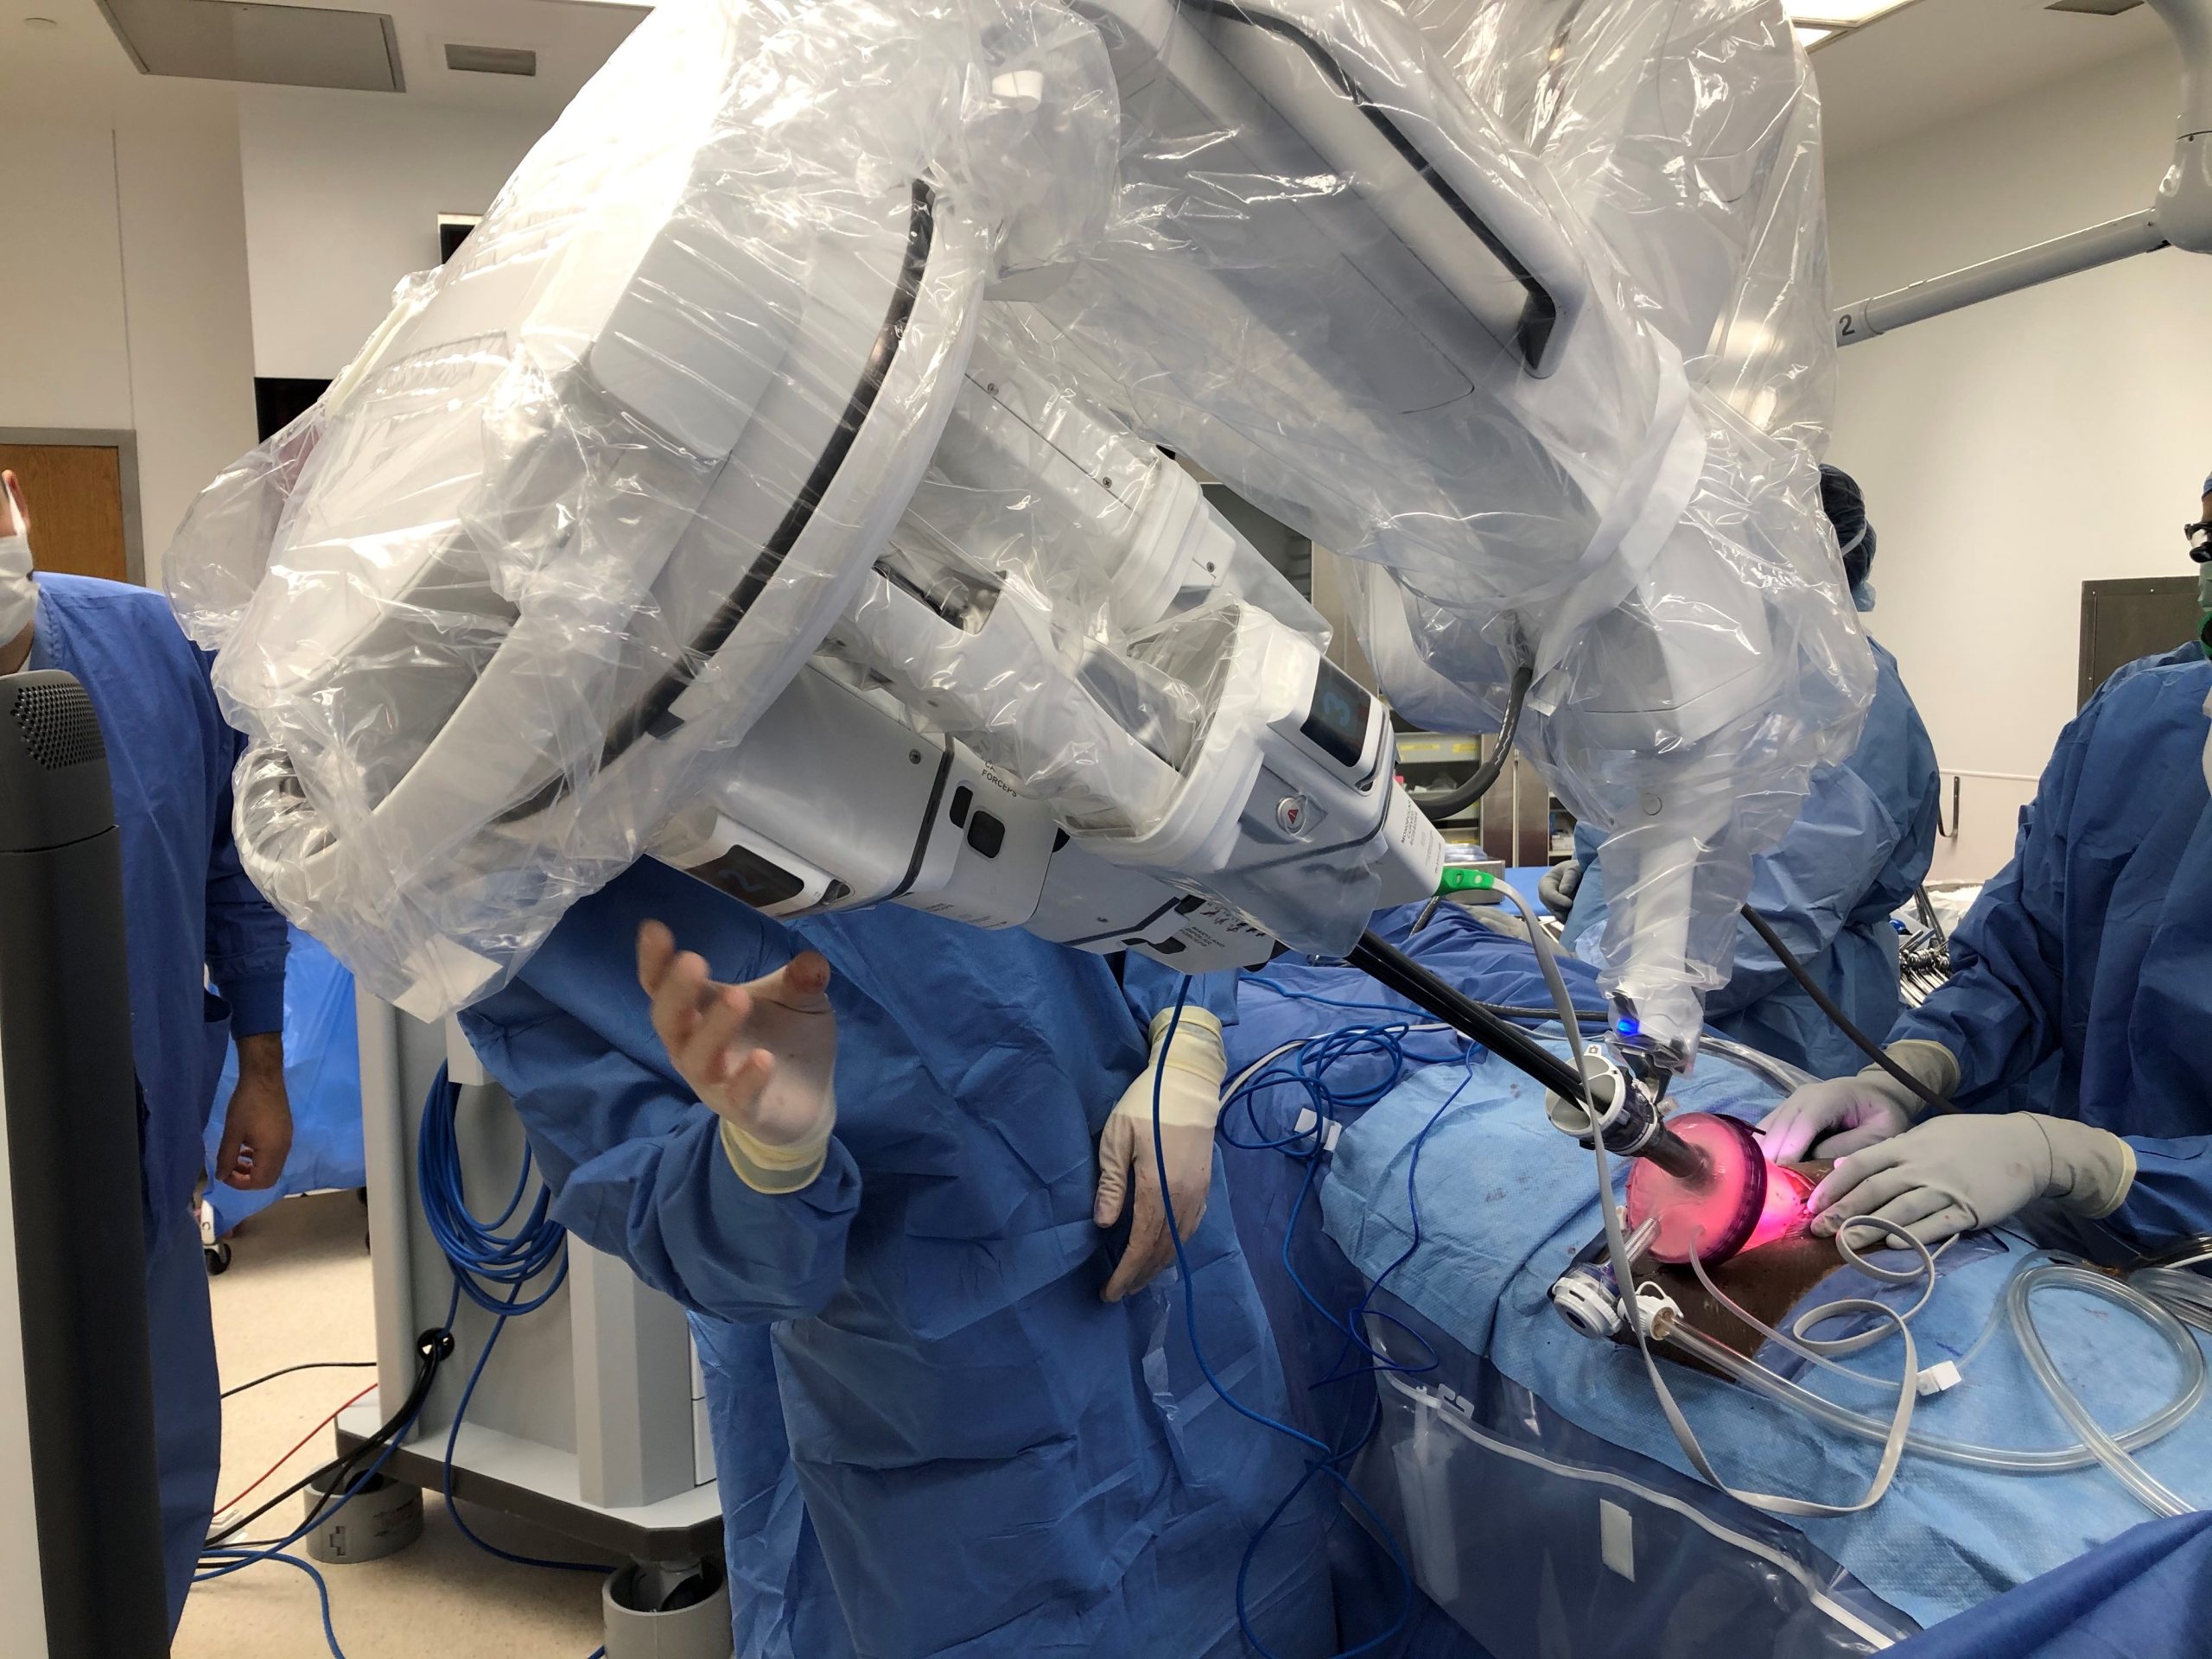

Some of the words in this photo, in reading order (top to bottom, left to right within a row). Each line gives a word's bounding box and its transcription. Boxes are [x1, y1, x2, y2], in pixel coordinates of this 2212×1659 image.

[1839, 314, 1856, 337] 2
[1322, 692, 1351, 727] 3
[982, 768, 1017, 798] FORCEPS
[718, 868, 764, 893] 2
